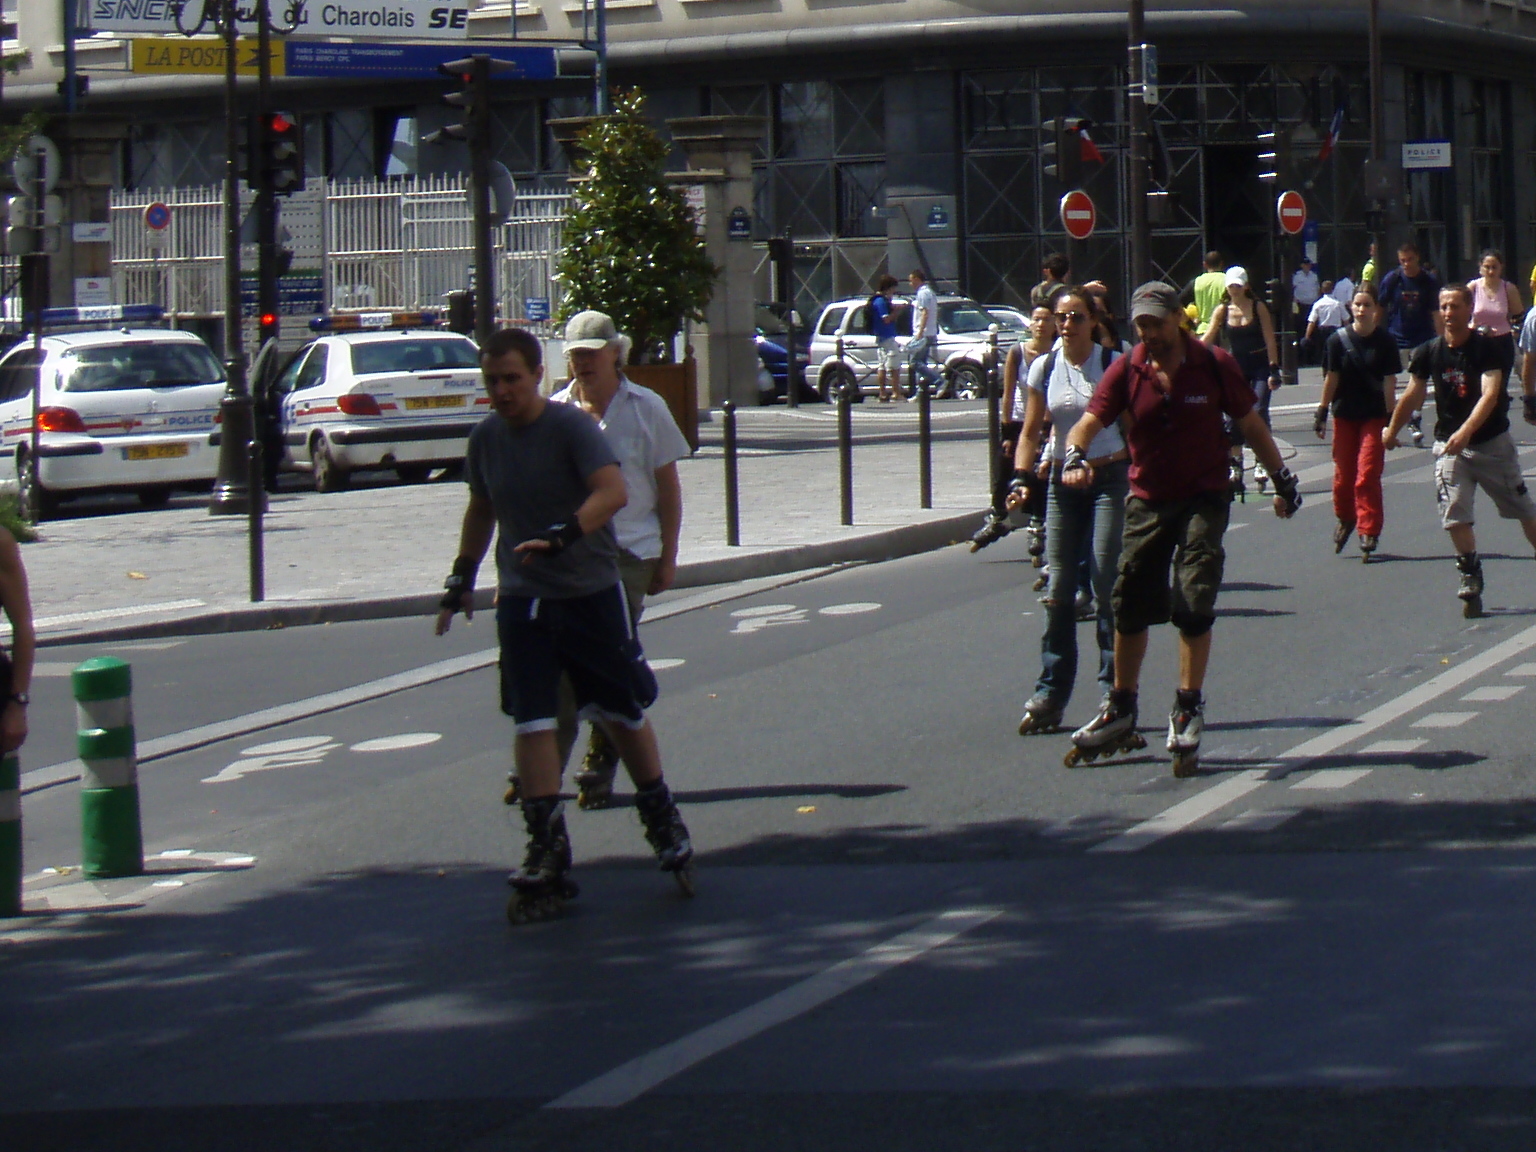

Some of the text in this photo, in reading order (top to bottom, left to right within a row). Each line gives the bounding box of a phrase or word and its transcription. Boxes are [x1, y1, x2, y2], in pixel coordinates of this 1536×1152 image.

[322, 4, 415, 27] Charolais
[428, 7, 469, 30] SE
[145, 47, 239, 67] LA POST
[1407, 148, 1441, 156] POLICE
[83, 309, 118, 319] POLICE
[443, 379, 476, 388] POLICE
[168, 413, 213, 426] POLICE
